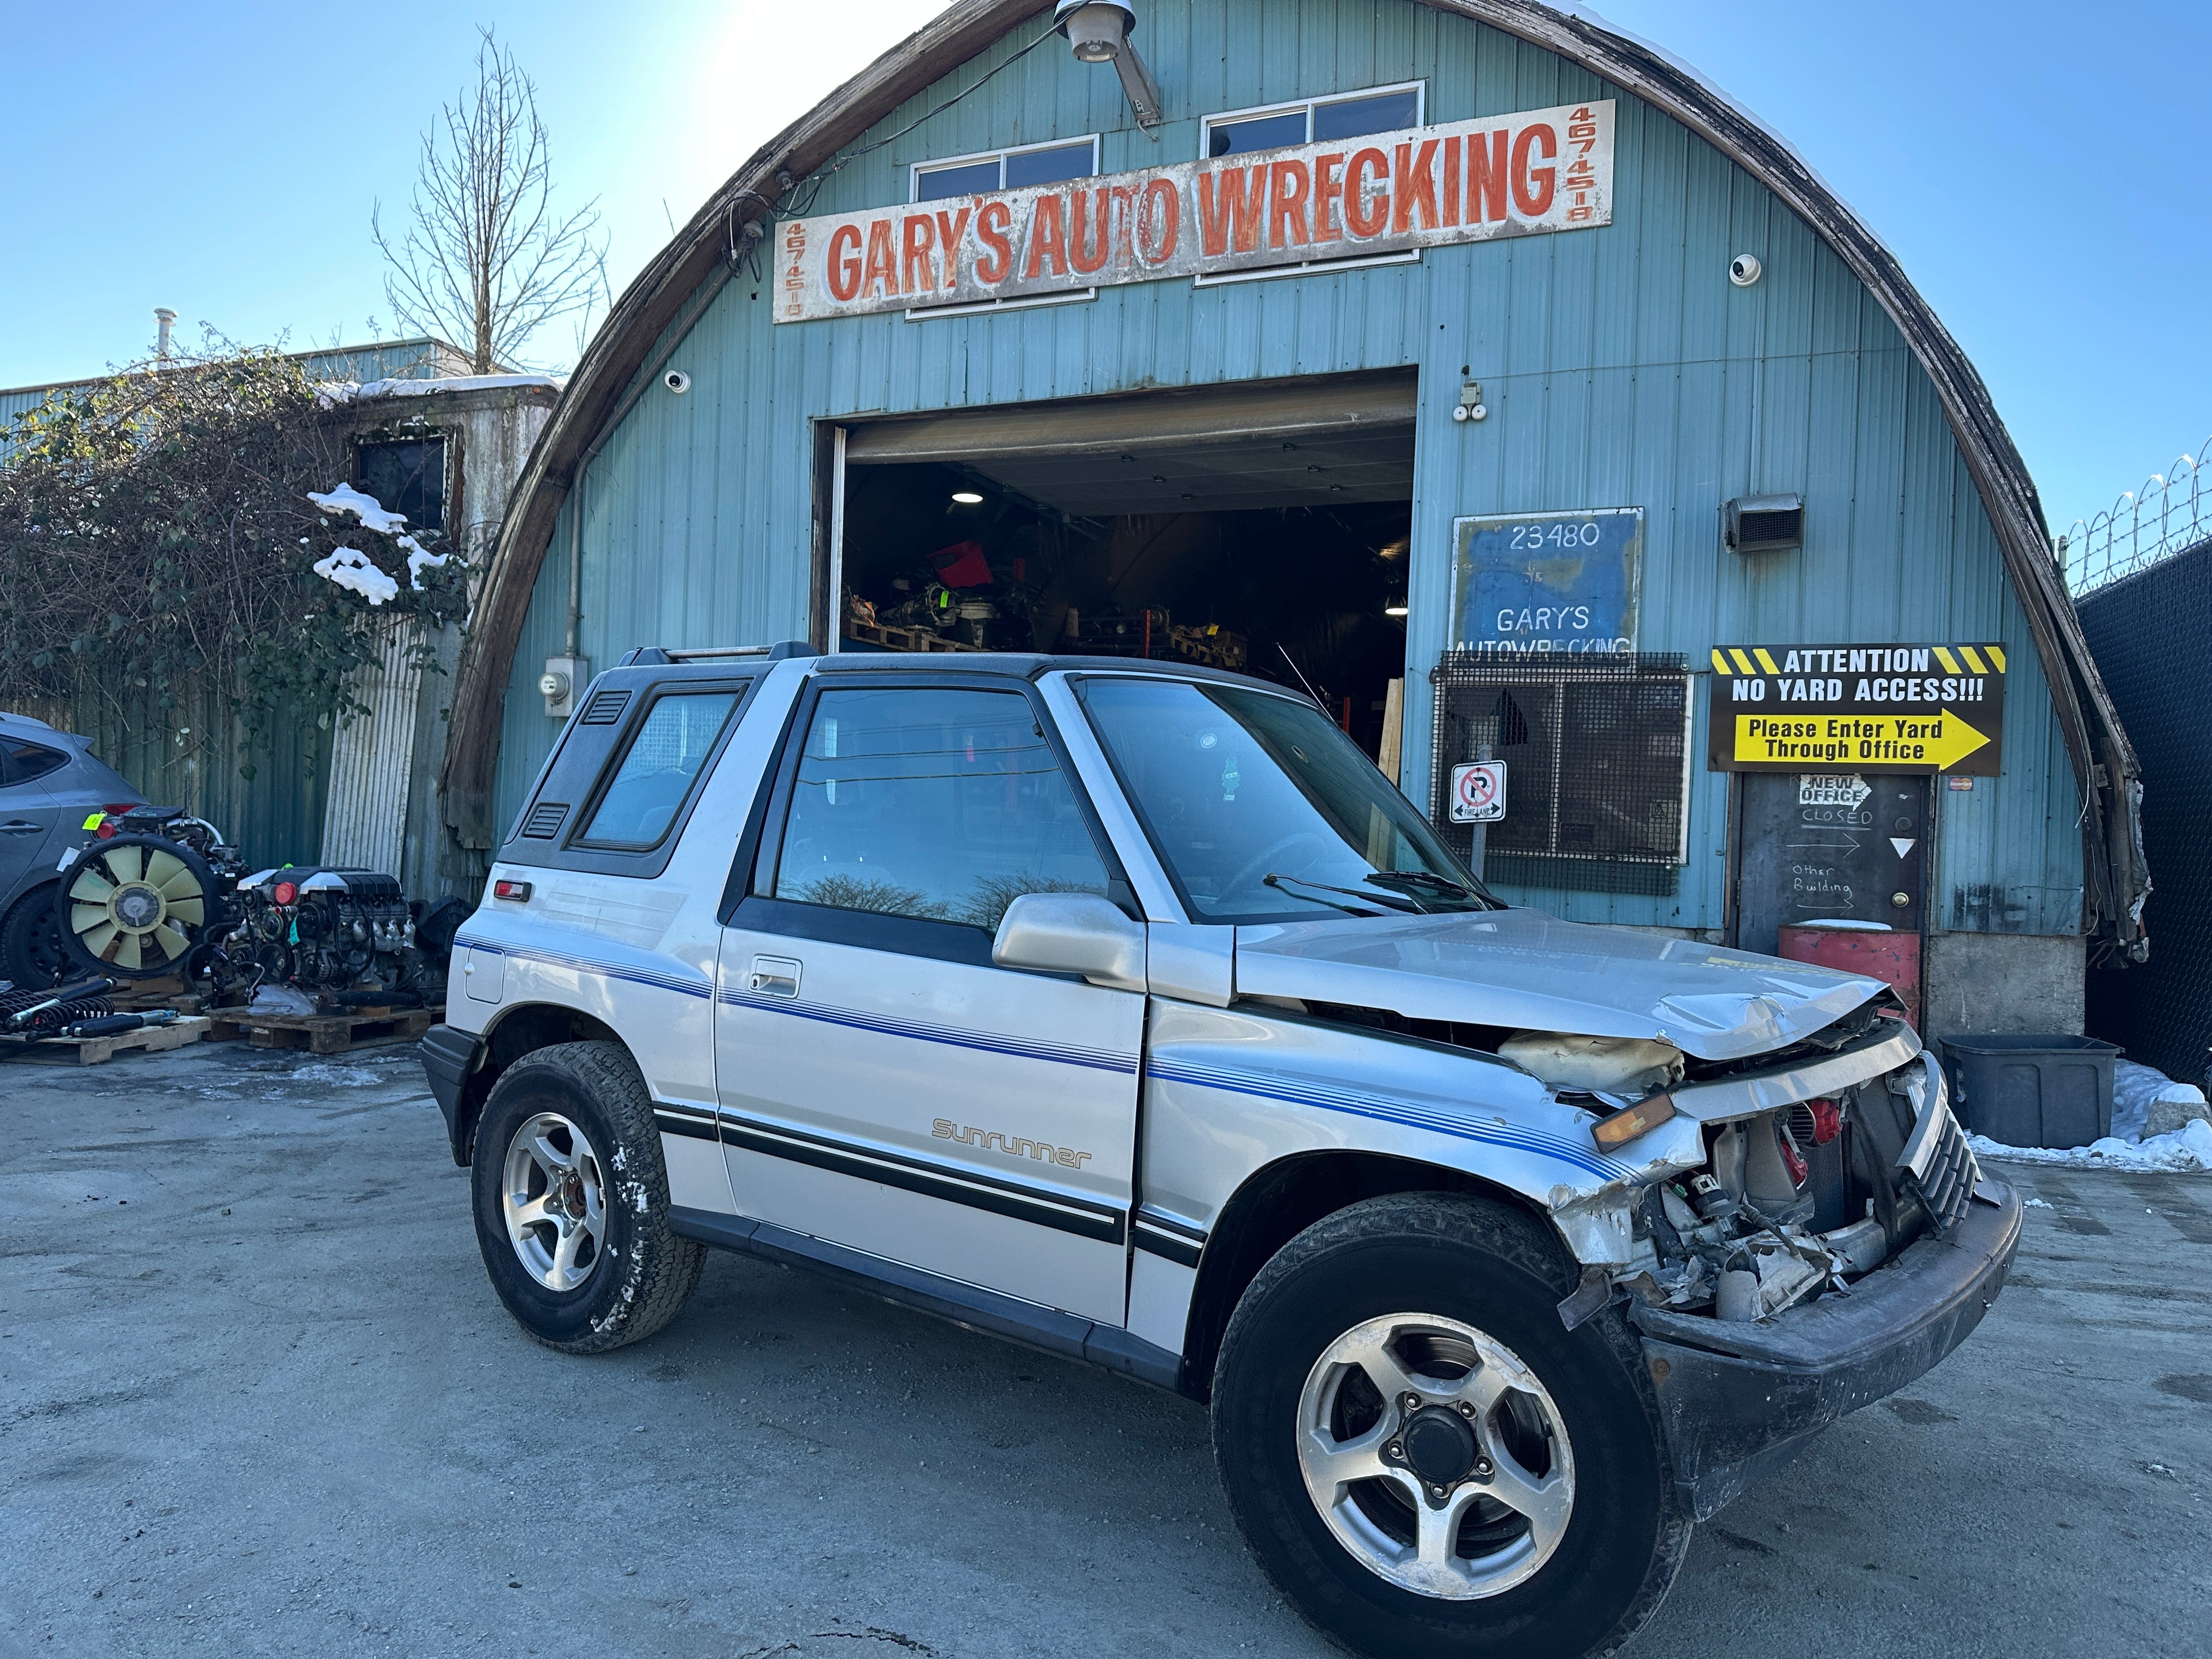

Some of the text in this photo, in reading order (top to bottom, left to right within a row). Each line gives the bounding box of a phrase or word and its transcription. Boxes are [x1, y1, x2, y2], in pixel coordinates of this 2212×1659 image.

[827, 123, 1557, 301] GARY'S AUTO WRECKING
[1510, 522, 1600, 549] 23480
[1497, 605, 1589, 632] GARY'S
[1783, 648, 1929, 673] ATTENTION
[1732, 677, 1984, 702] NO YARD ACCESS!!!
[1749, 718, 1943, 739] Please Enter Yard
[1765, 738, 1925, 761] Through Office
[1810, 777, 1854, 789] NEW
[1801, 788, 1863, 802] OFFICE
[1464, 808, 1475, 816] FIRE
[1802, 809, 1872, 824] CLOSED
[1794, 877, 1853, 900] Building
[931, 1118, 1092, 1169] Sunrunner
